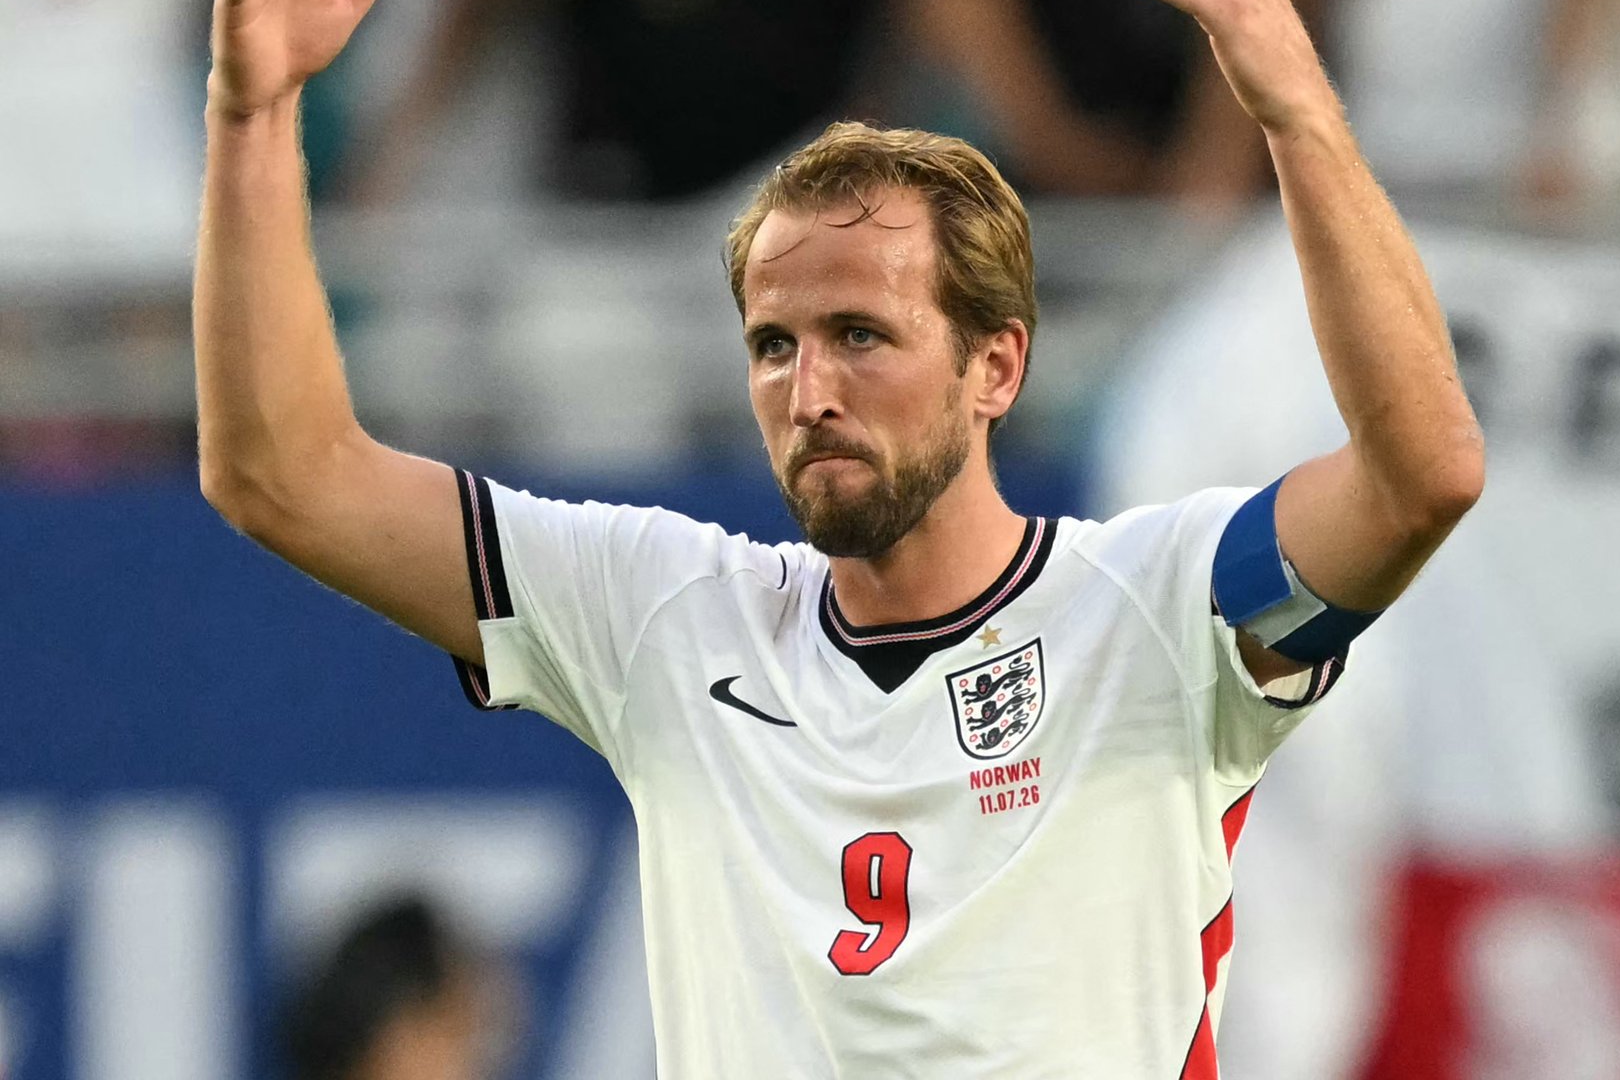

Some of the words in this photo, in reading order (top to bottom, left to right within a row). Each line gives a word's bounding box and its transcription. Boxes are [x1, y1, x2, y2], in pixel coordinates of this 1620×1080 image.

[969, 756, 1042, 790] NORWAY
[979, 784, 1041, 815] 11.07.26
[827, 831, 914, 976] 9
